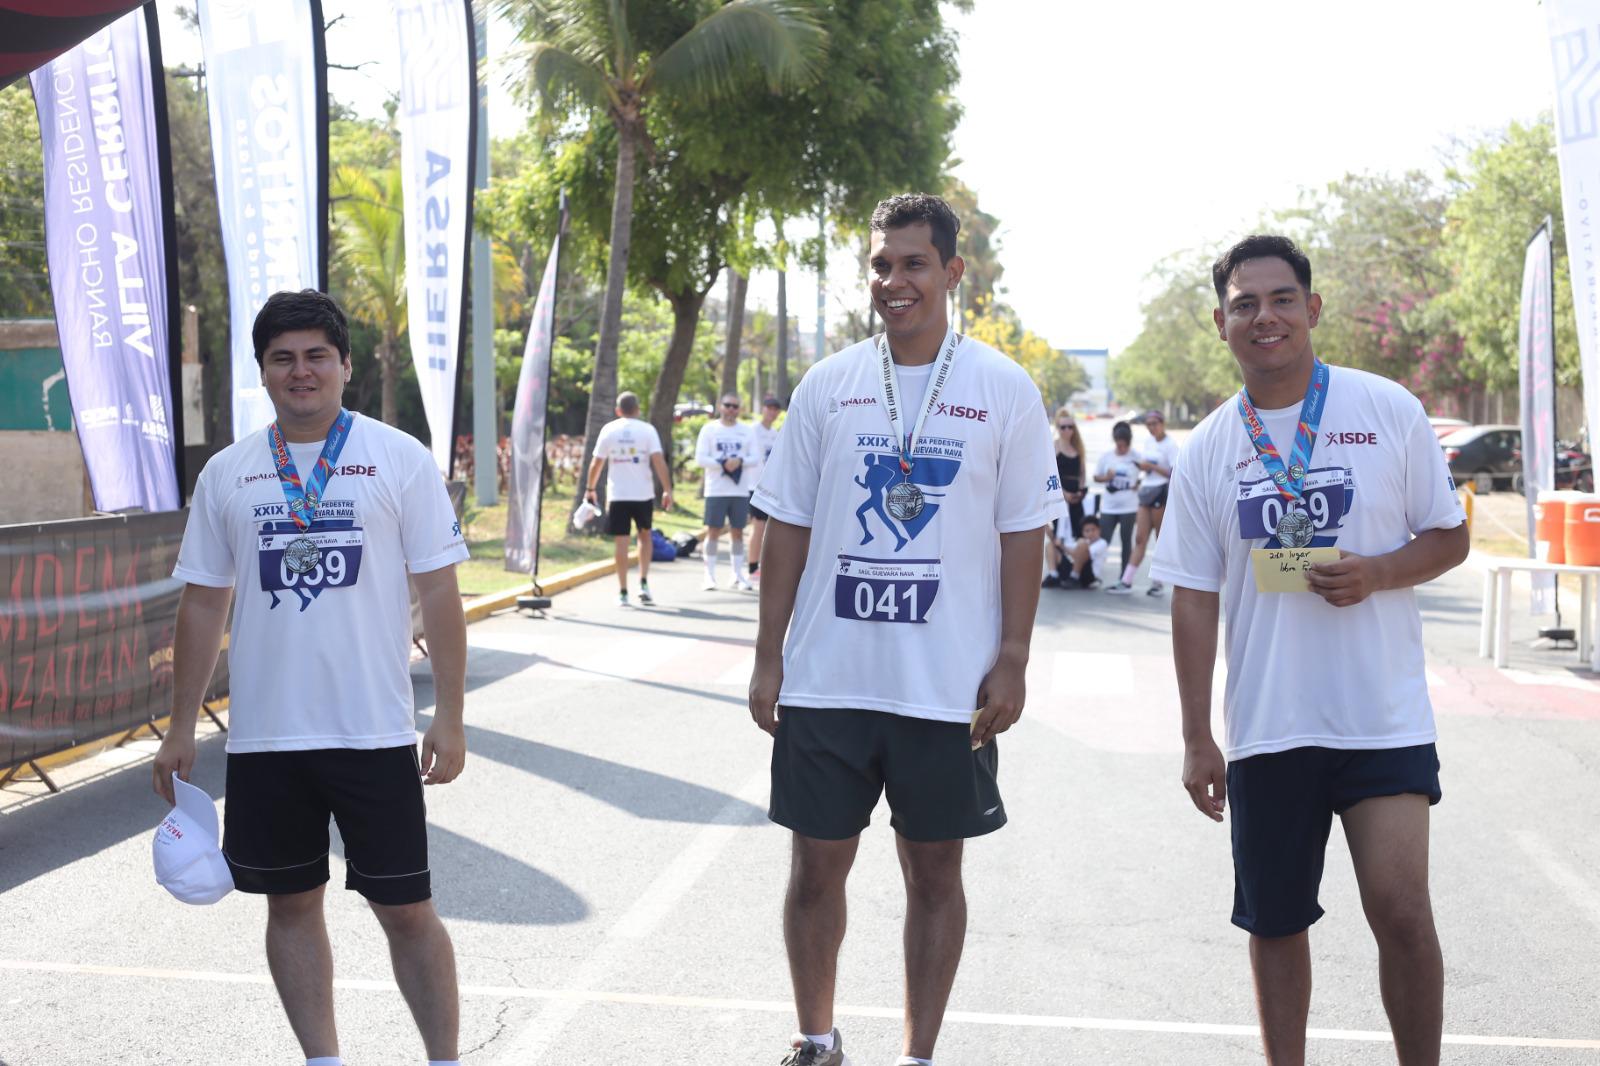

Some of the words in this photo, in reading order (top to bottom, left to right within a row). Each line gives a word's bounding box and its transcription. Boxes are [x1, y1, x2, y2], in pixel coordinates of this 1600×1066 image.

[840, 397, 877, 407] SINALOA
[949, 405, 988, 422] ISDE
[857, 436, 889, 447] XXIX
[929, 438, 964, 449] PEDESTRE
[1339, 432, 1377, 445] ISDE
[944, 448, 962, 457] NAVA
[341, 464, 376, 476] ISDE
[254, 505, 284, 517] XXIX
[314, 509, 334, 517] EVARA
[854, 581, 918, 621] 041
